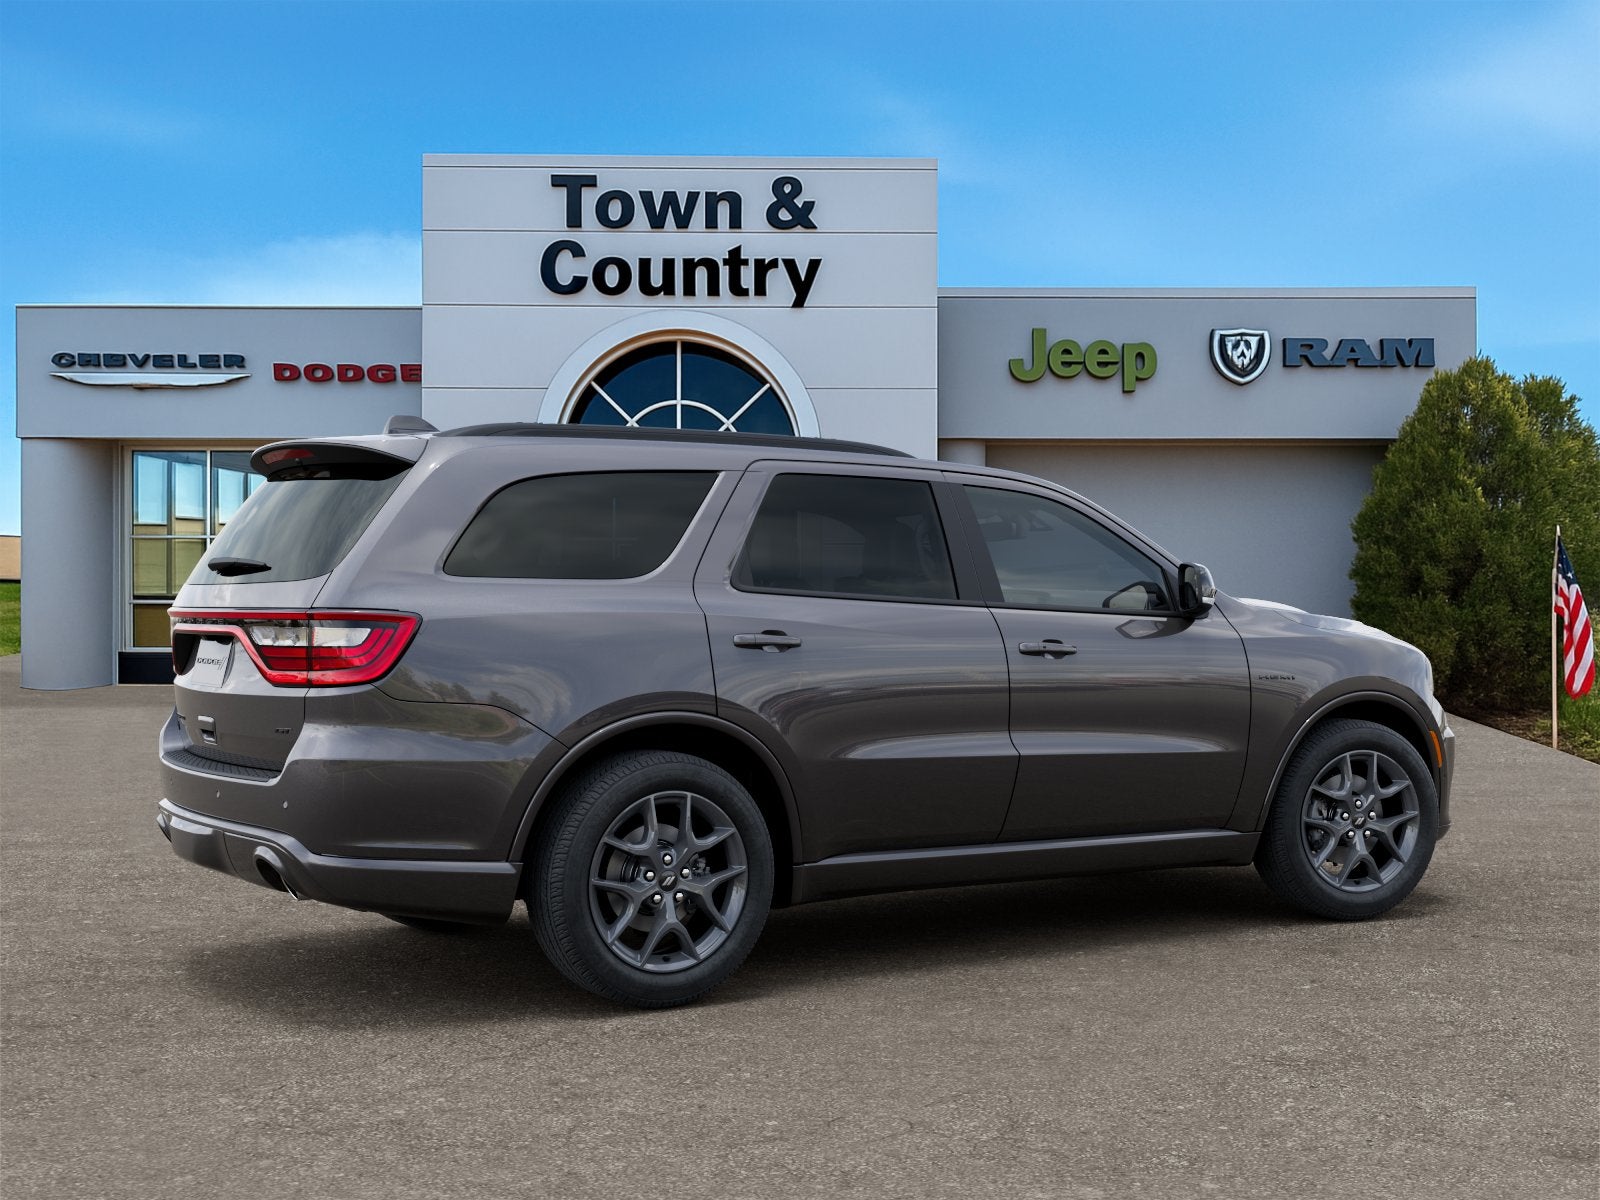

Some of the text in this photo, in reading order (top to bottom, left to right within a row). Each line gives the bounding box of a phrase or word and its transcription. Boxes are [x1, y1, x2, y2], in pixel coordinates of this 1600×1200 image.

[551, 174, 818, 230] Town &
[540, 239, 822, 308] Country
[273, 363, 422, 383] DODGE
[1008, 328, 1158, 393] Jeep
[1283, 337, 1435, 367] RAM
